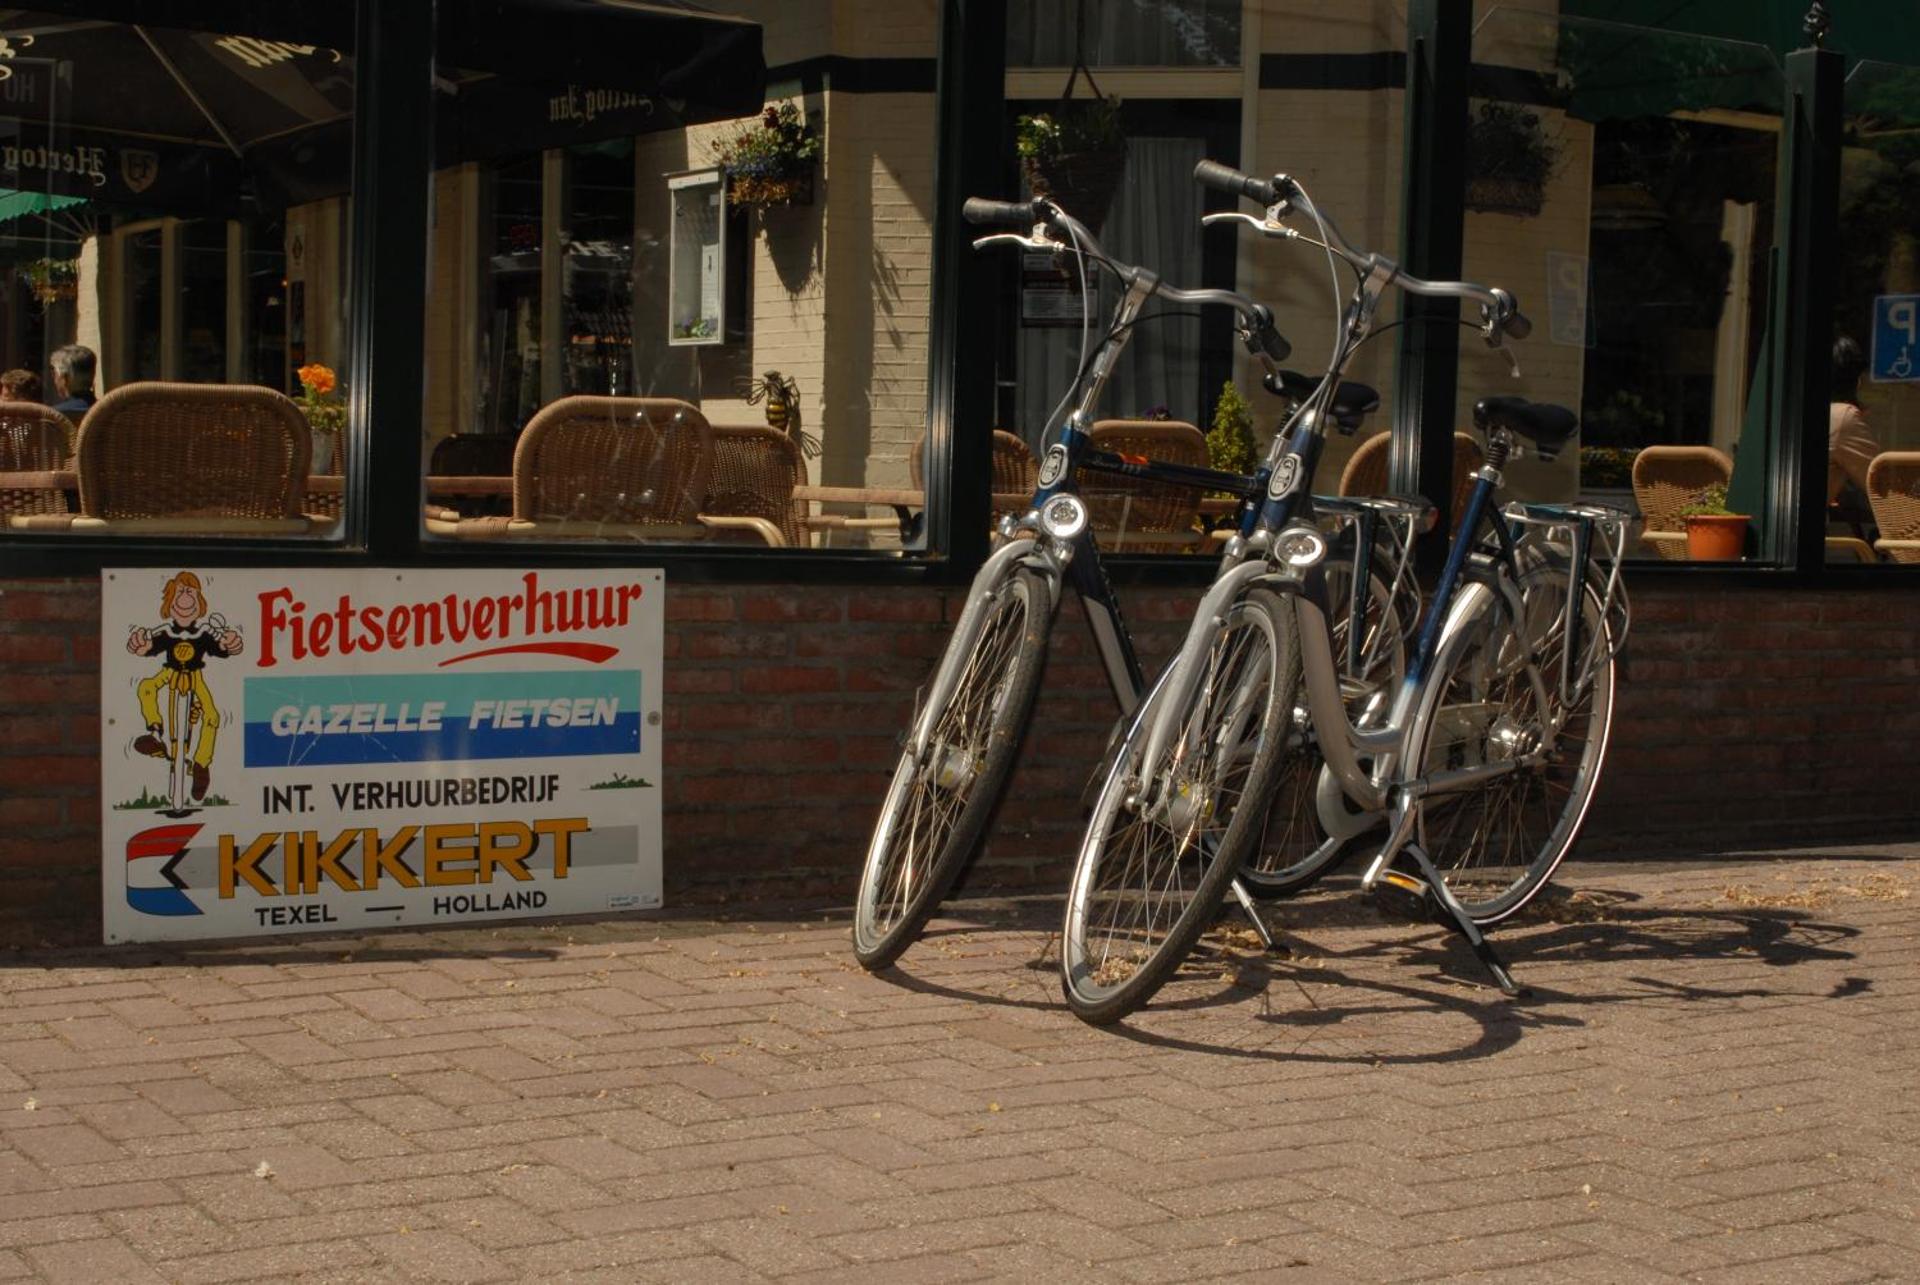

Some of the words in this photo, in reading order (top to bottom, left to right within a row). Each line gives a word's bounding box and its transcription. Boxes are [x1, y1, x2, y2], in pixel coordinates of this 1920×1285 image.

[257, 572, 642, 667] Fietsenverhuur
[270, 700, 445, 737] GAZELLE
[468, 697, 619, 731] FIETSEN
[262, 784, 315, 814] INT.
[331, 774, 560, 812] VERHUURBEDRIJF
[218, 817, 592, 899] KIKKERT
[254, 904, 338, 926] TEXEL
[433, 890, 547, 915] HOLLAND
